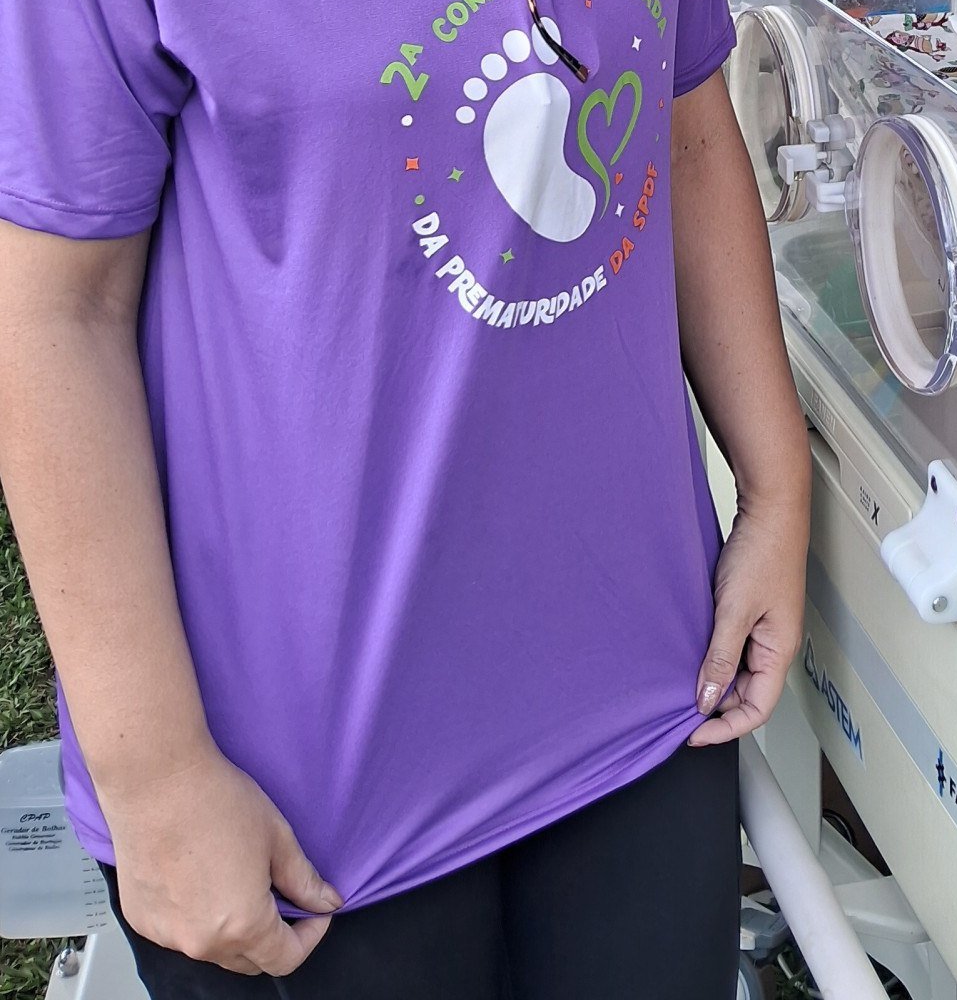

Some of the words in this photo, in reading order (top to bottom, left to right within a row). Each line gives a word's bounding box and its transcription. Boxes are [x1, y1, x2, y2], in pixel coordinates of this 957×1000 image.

[412, 211, 449, 259] DA
[435, 254, 609, 330] PREMATURIDADE
[609, 236, 635, 275] DA
[821, 671, 864, 762] ASTEM
[19, 812, 51, 823] CPAP
